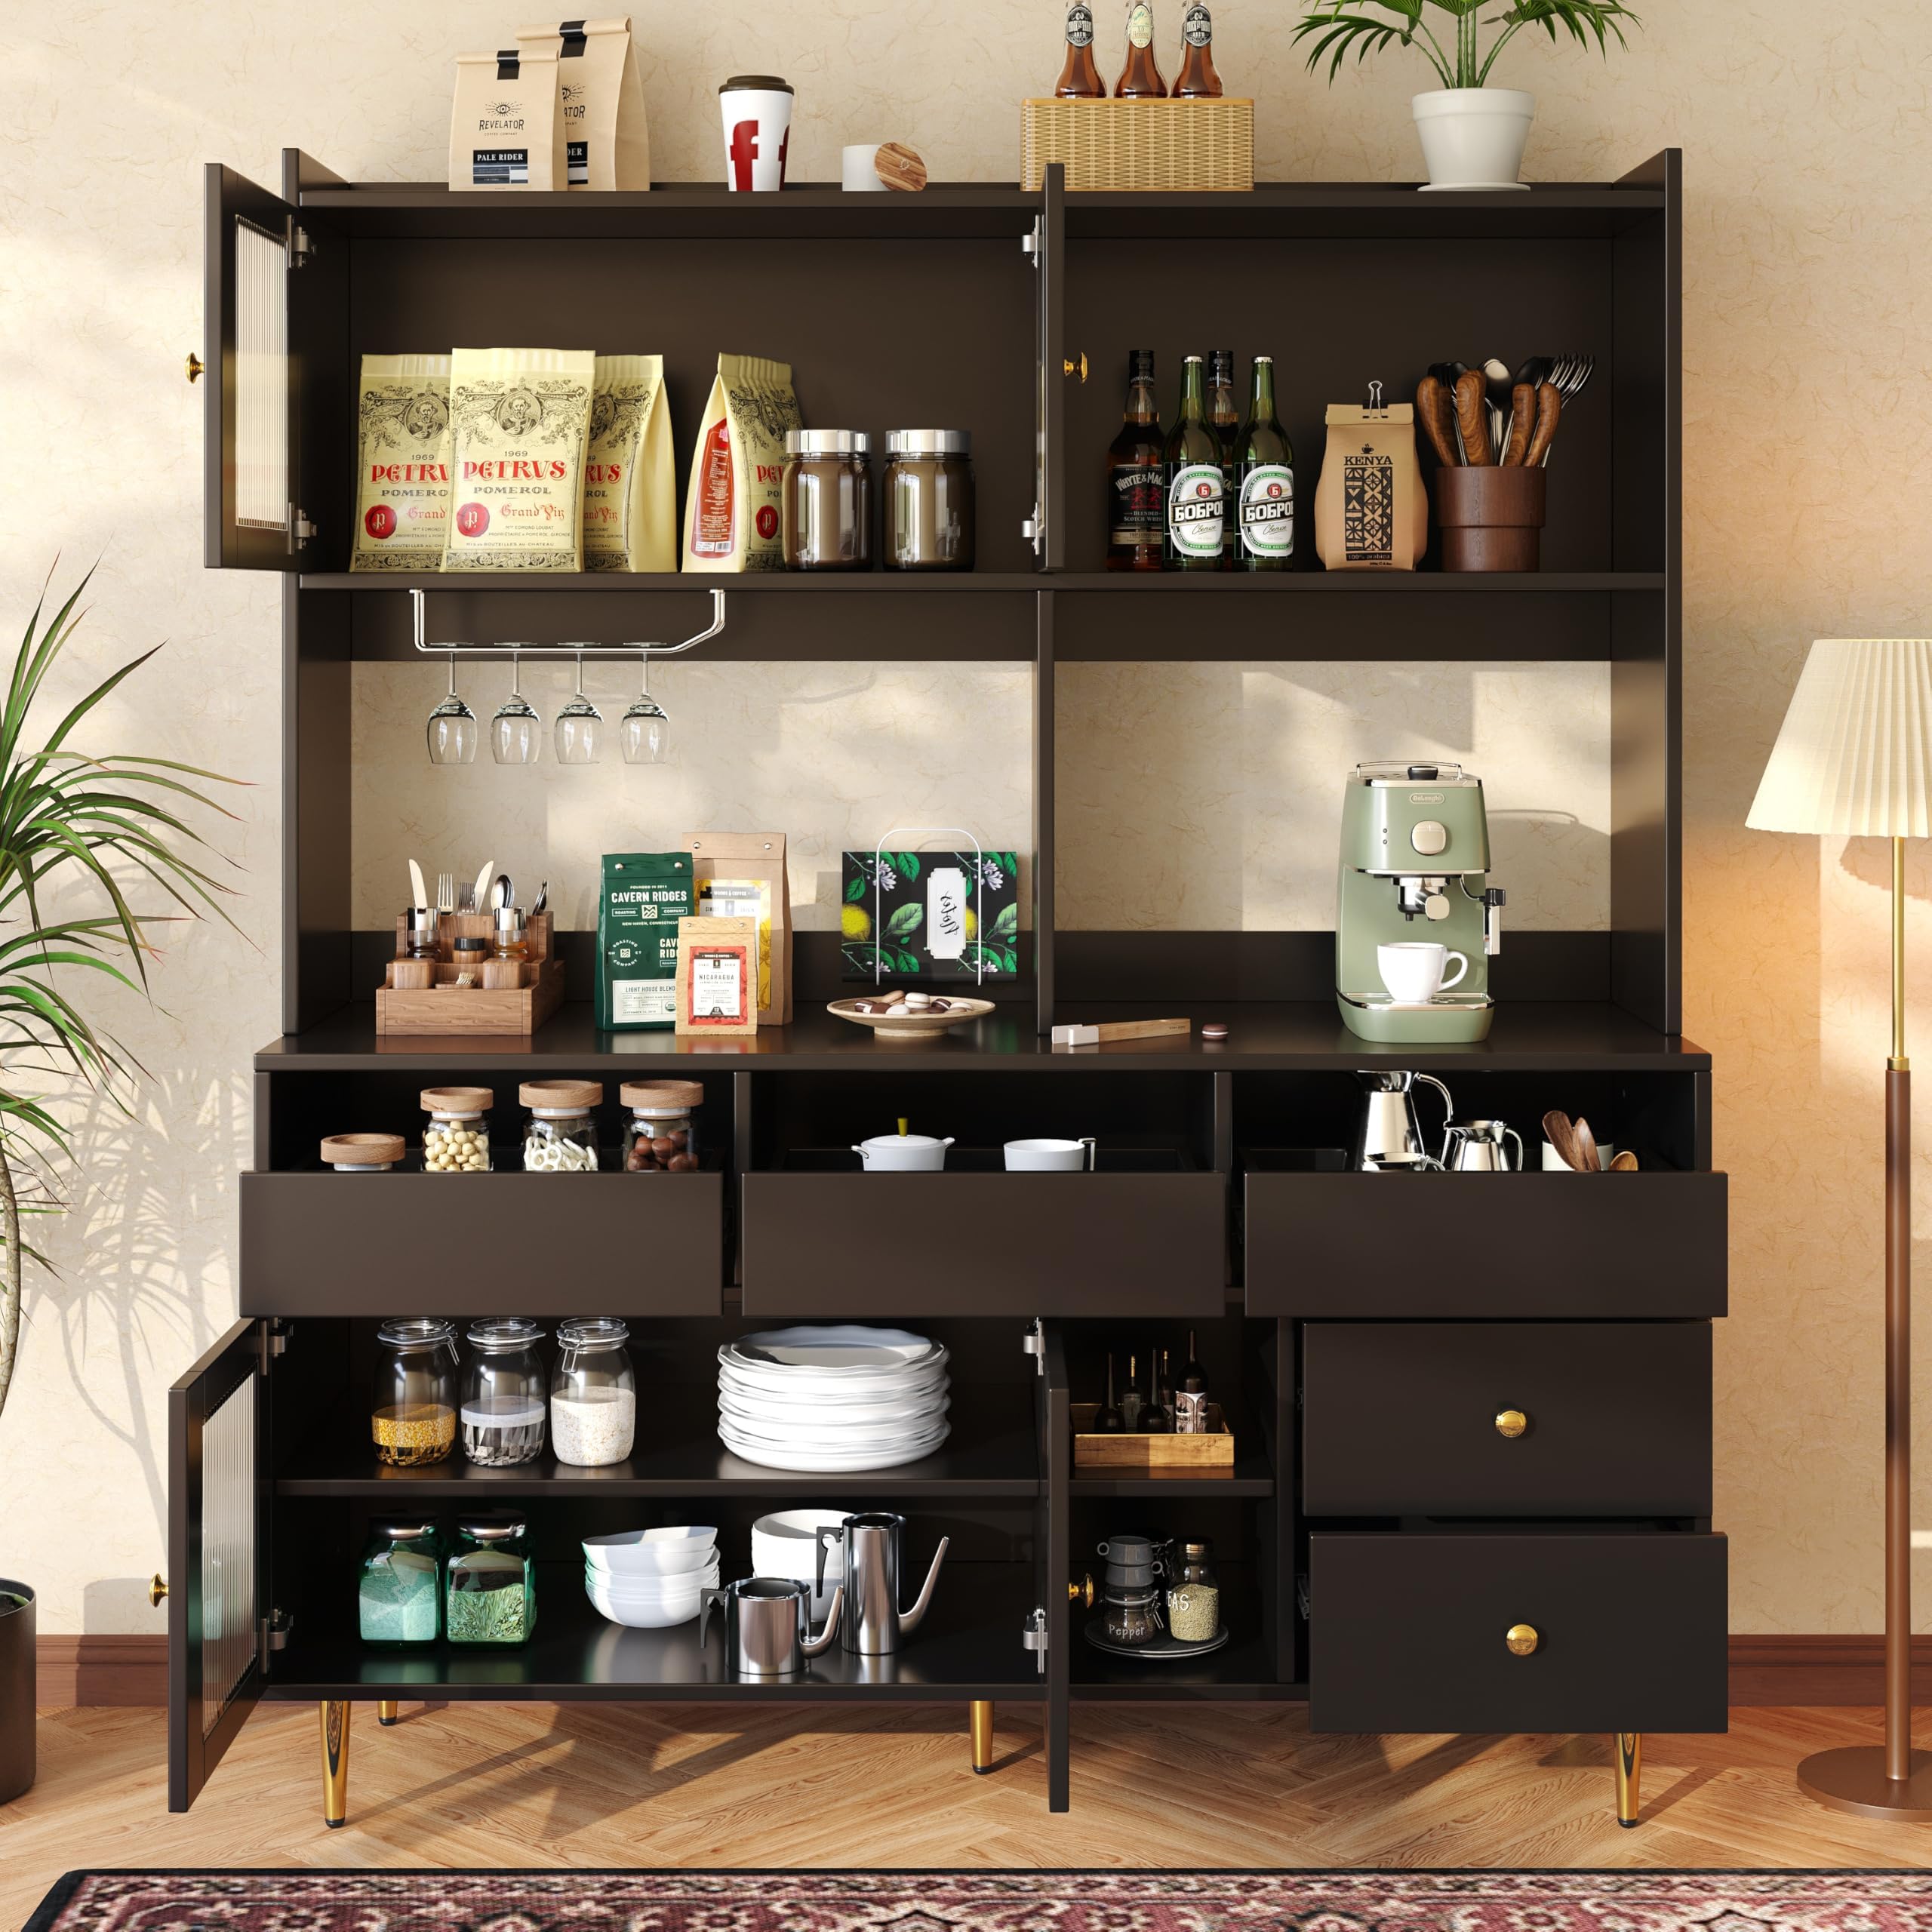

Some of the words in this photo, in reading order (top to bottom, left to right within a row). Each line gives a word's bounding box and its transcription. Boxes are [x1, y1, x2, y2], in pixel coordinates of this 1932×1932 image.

[478, 118, 525, 131] REVELATOR
[568, 147, 583, 156] DER
[1344, 456, 1393, 466] KENYA
[371, 463, 449, 484] PETRV
[756, 465, 783, 484] PET
[1115, 473, 1142, 491] WHYTE
[1147, 471, 1163, 485] MAC
[473, 486, 552, 494] POMEROL
[407, 505, 447, 521] Grand
[500, 502, 540, 518] Grand
[584, 506, 598, 520] and
[1174, 501, 1223, 522] БОБРО
[1245, 501, 1293, 522] БОБРО
[611, 891, 650, 903] CAVERN
[652, 891, 688, 903] RIDGES
[613, 939, 638, 948] ROASTING
[660, 938, 679, 948] CAV
[660, 949, 678, 958] RID
[1168, 1590, 1189, 1611] EAS
[1109, 1624, 1145, 1639] Pepper
